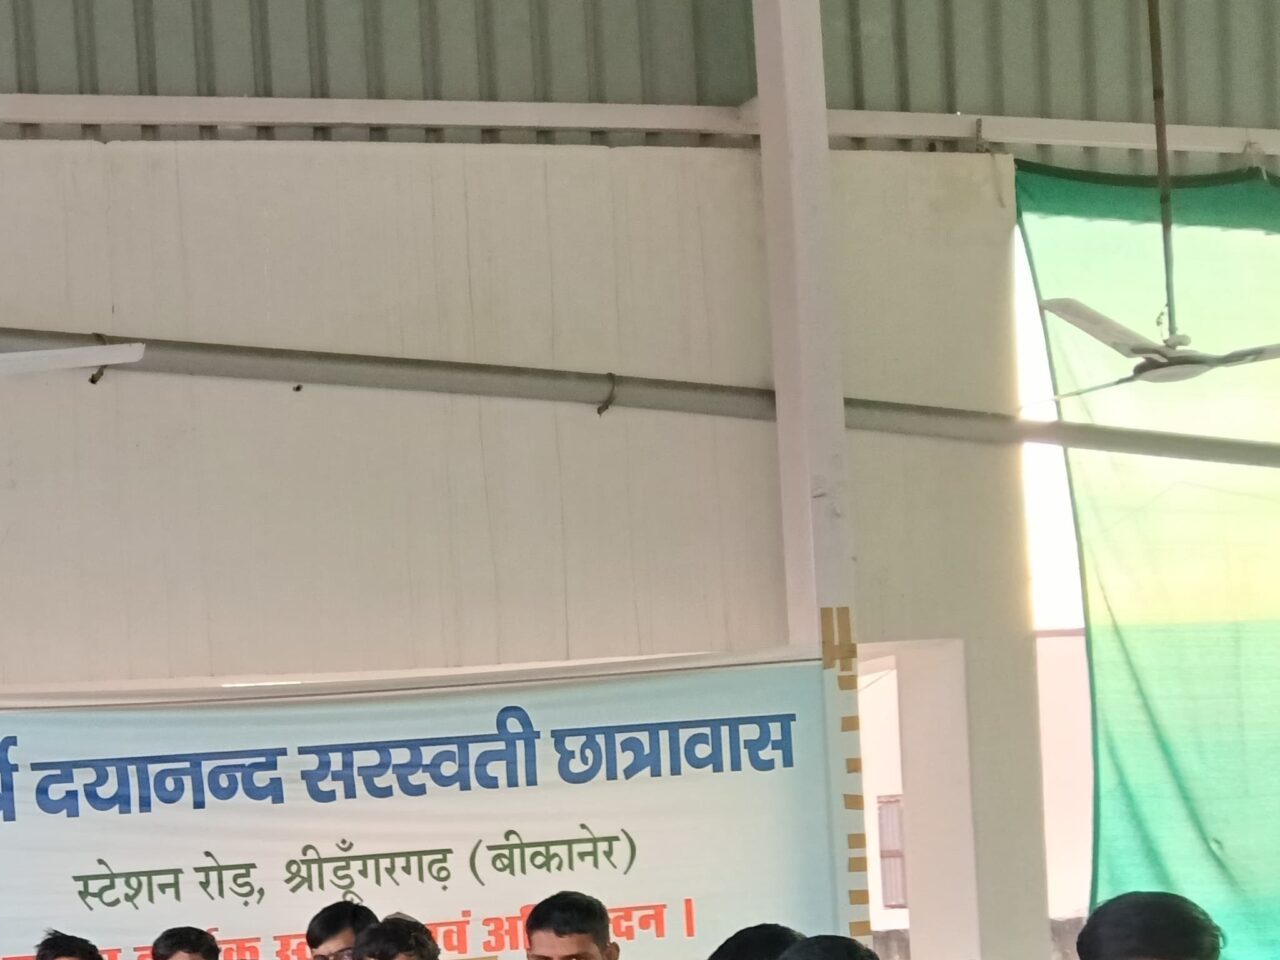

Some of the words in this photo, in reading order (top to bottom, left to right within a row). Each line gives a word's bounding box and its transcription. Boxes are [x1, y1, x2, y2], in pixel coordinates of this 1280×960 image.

[30, 747, 288, 818] दयानन्द
[297, 705, 540, 803] सरस्वती
[550, 713, 797, 784] छात्रावास
[72, 858, 184, 911] स्टेशन
[194, 851, 265, 908] रोड़,
[470, 823, 637, 885] (बीकानेर)
